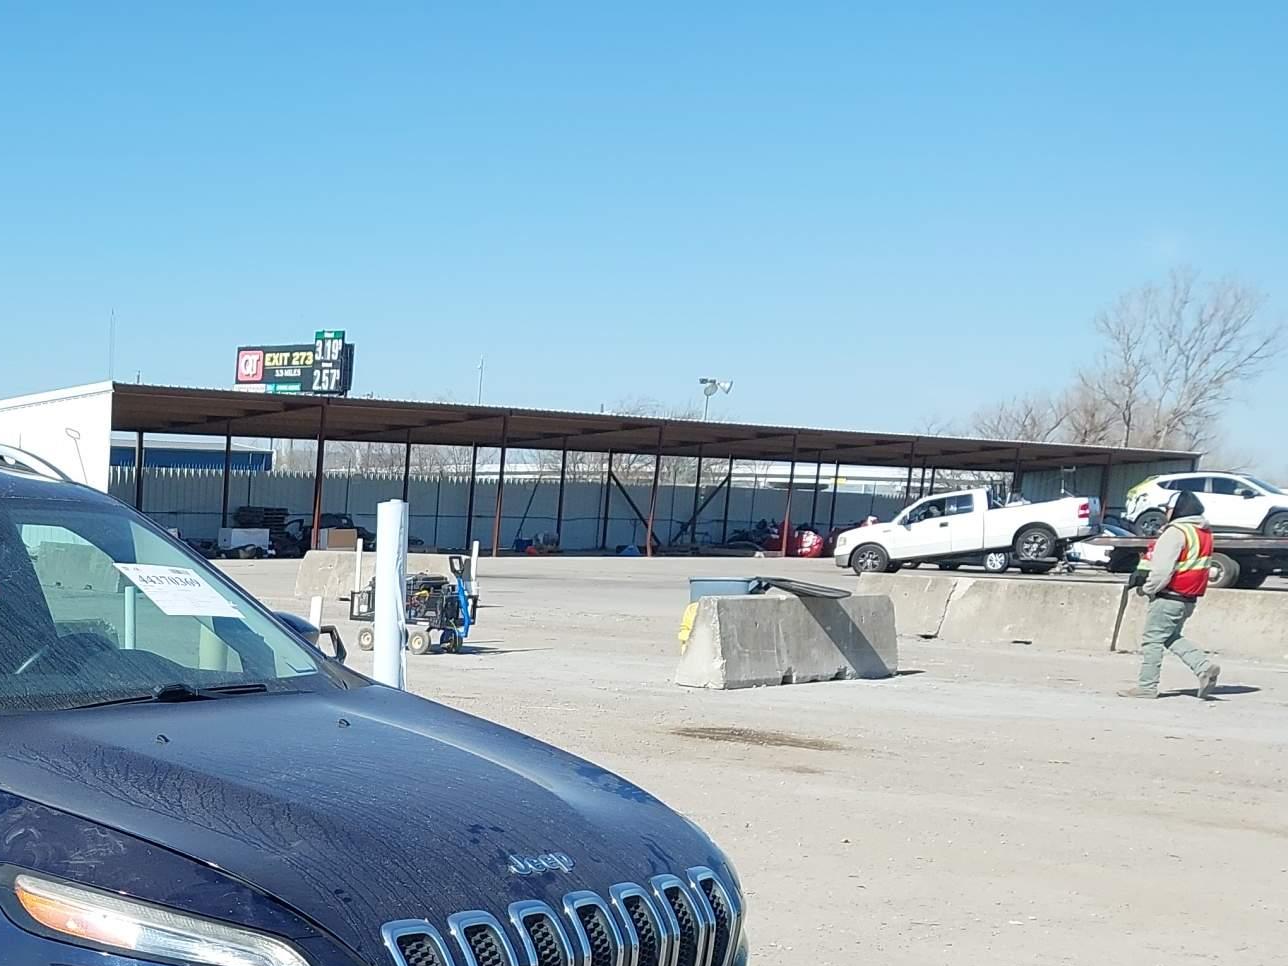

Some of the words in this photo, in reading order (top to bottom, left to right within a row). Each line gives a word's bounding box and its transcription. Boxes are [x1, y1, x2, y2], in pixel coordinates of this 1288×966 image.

[240, 354, 260, 378] QT
[264, 353, 290, 367] EXIT
[291, 351, 313, 366] 273
[508, 852, 575, 875] Jeep
